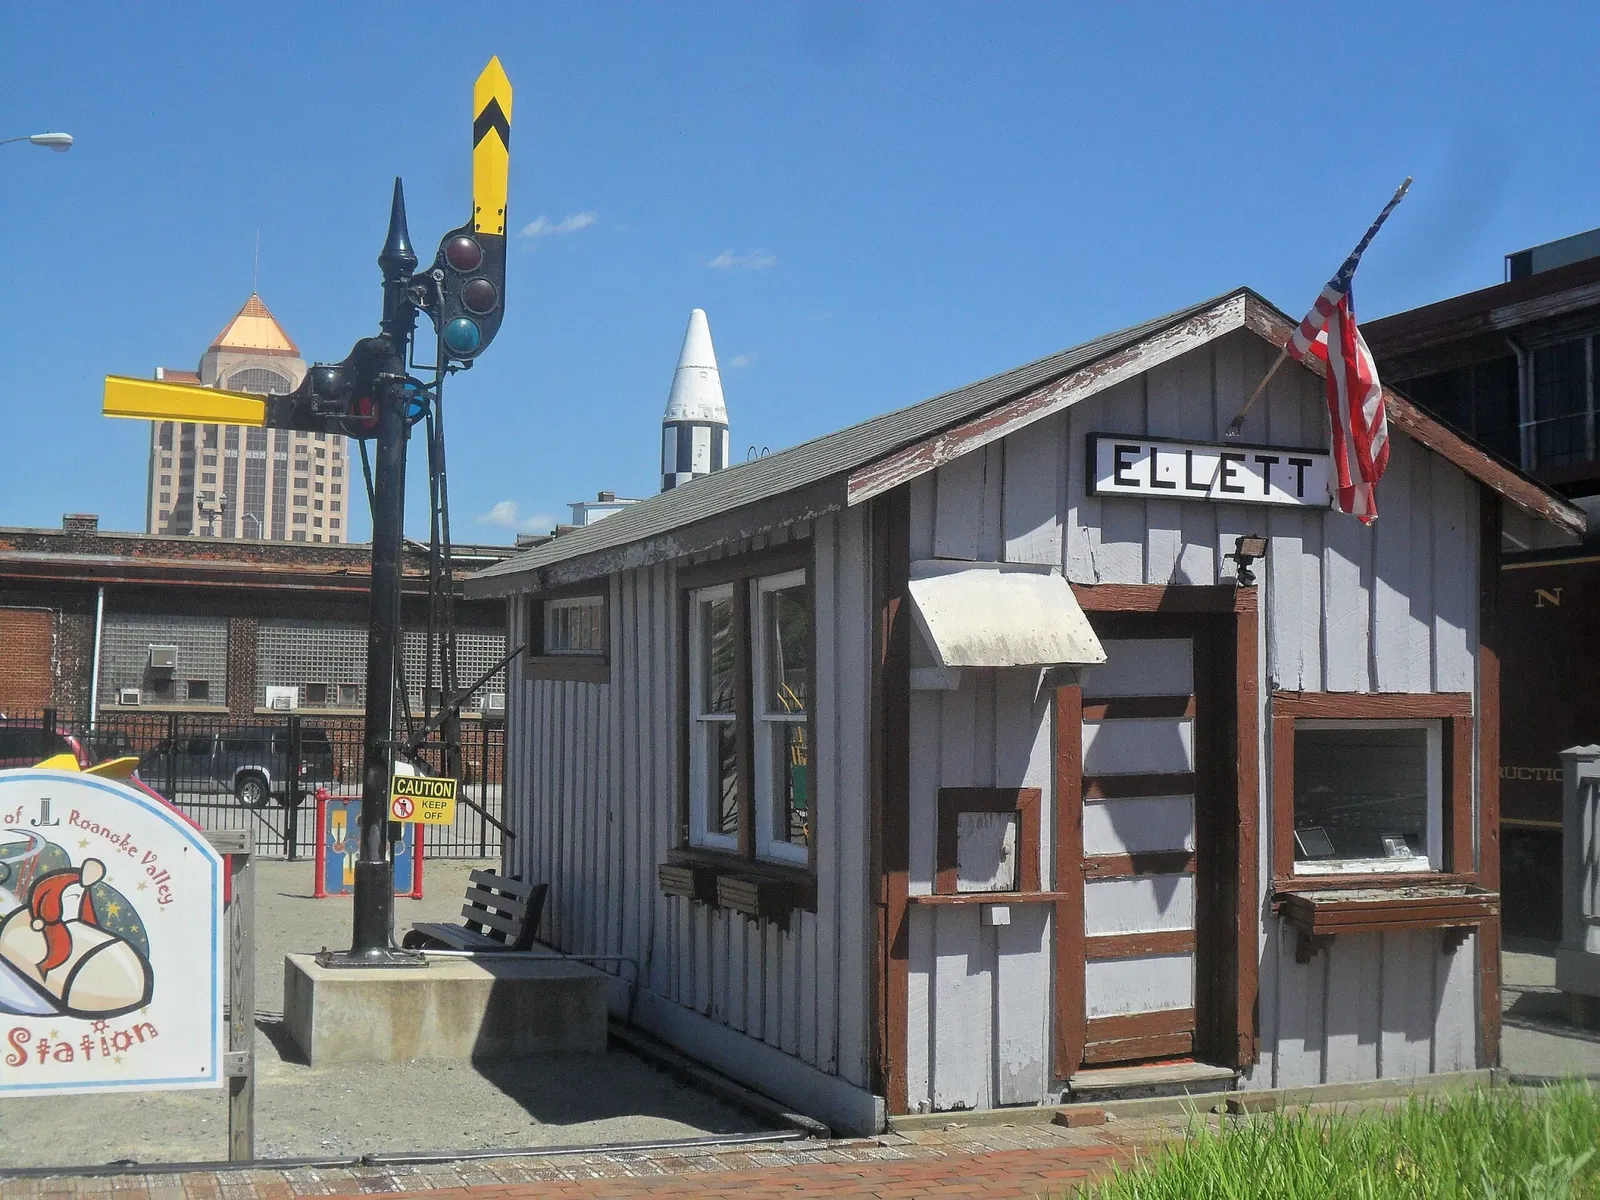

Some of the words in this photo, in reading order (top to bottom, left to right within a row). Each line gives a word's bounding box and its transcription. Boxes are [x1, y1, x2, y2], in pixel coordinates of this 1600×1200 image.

[1114, 444, 1313, 498] ELLETT
[1535, 587, 1563, 608] N
[397, 778, 452, 798] CAUTION
[421, 800, 447, 810] KEEP
[424, 811, 443, 820] OFF
[4, 806, 24, 824] of
[68, 809, 138, 858] Roanoke
[141, 850, 174, 905] Valley
[5, 1018, 159, 1068] Station
